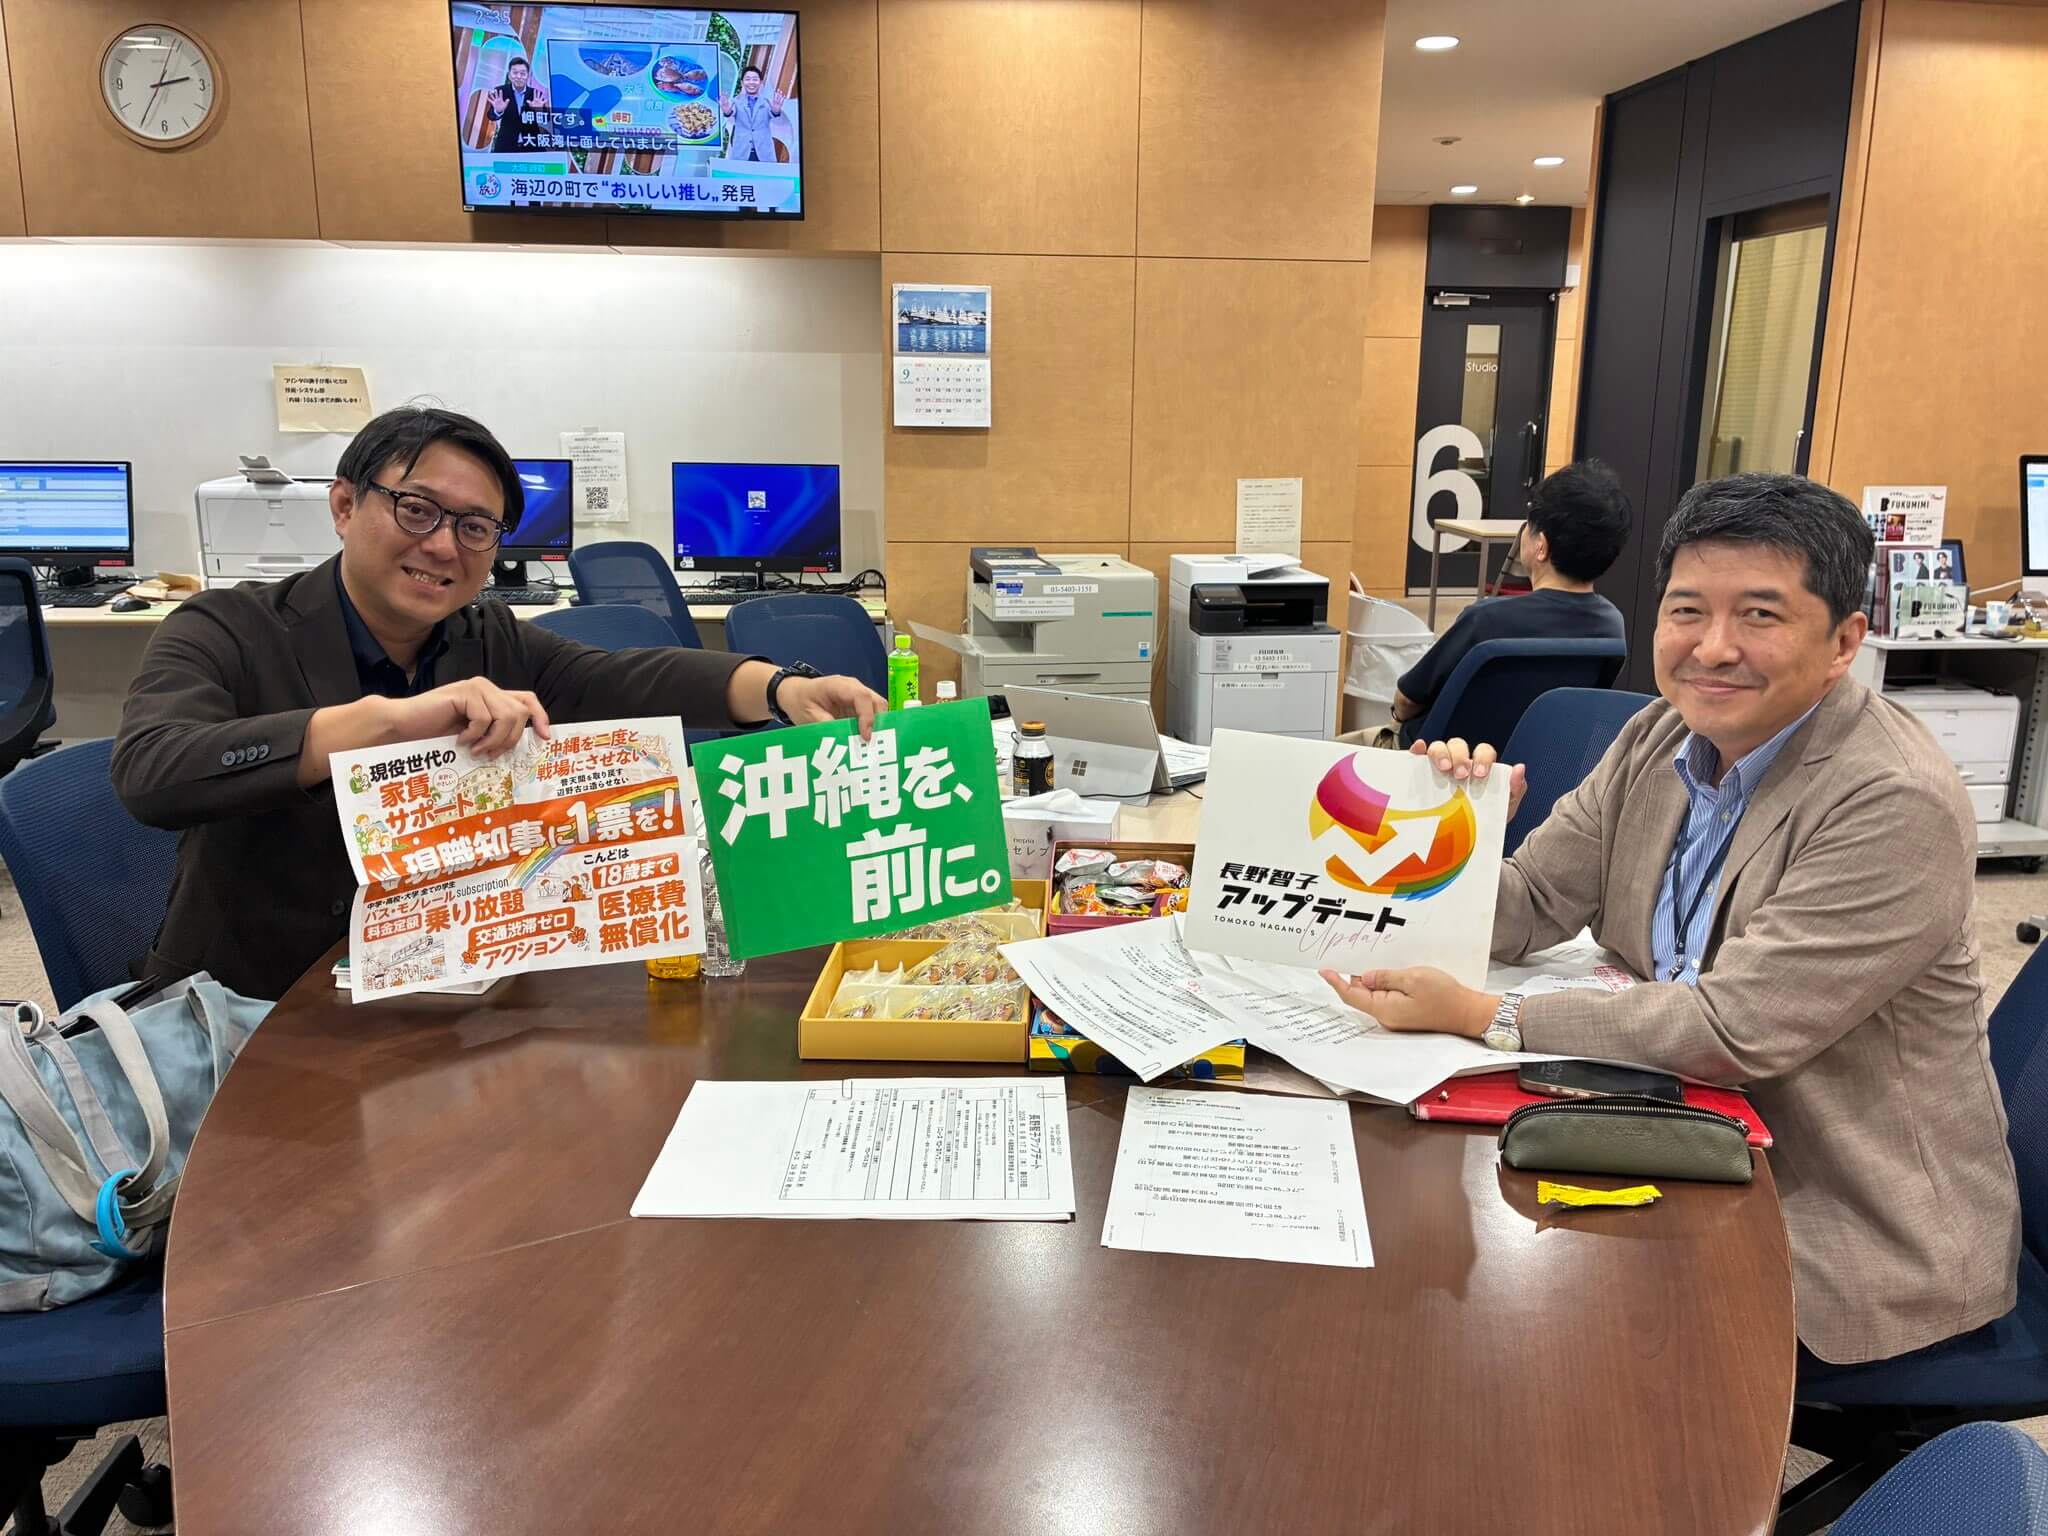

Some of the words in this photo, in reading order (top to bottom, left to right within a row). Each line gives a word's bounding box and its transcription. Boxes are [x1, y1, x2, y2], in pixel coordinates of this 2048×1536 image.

[523, 134, 677, 151] 大阪湾に面していまして
[901, 367, 910, 380] 9
[1465, 361, 1498, 373] Studio
[1412, 424, 1484, 554] 6
[1890, 500, 1930, 509] FUKUMIMI
[545, 728, 640, 758] 沖縄を二度と
[369, 750, 456, 782] 現役世代の
[536, 749, 649, 782] 戦場にさせない
[560, 768, 624, 787] 普天間を取り戻す
[379, 773, 431, 808] 家賃
[556, 776, 630, 797] 辺野古は造らせない
[718, 728, 973, 846] 沖縄を、
[385, 793, 474, 834] サポート
[583, 848, 630, 865] こんどは
[457, 878, 509, 898] subscription
[597, 858, 674, 888] 18歳まで
[846, 823, 1001, 924] 前に。
[1219, 862, 1320, 890] 長野智子
[365, 890, 457, 923] バス・モノレール
[425, 888, 525, 934] 乗り放題
[598, 880, 687, 921] 医療費
[1217, 884, 1408, 933] アップデート
[367, 916, 421, 938] 料金定額
[475, 913, 568, 947] 交通渋滞ゼロ
[599, 911, 689, 953] 無償化
[1214, 915, 1256, 927] TOMOKO
[1299, 912, 1394, 960] Update
[483, 936, 567, 970] アクション
